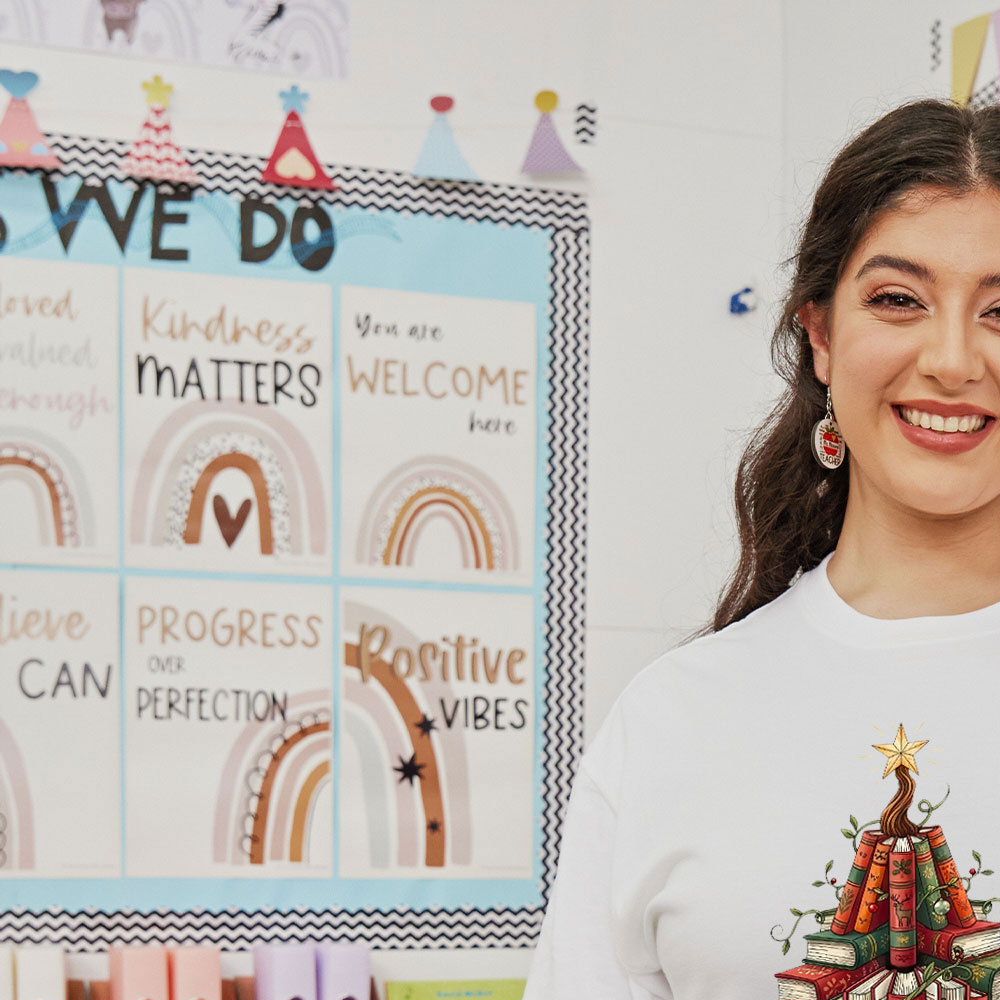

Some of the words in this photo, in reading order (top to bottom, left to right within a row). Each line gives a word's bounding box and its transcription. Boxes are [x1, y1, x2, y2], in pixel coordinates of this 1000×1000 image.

[41, 176, 192, 262] WE
[239, 200, 336, 272] DO
[141, 294, 317, 354] Kindness
[355, 312, 399, 339] You
[408, 323, 446, 343] are
[347, 353, 530, 406] WELCOME
[468, 410, 518, 435] here
[138, 605, 323, 648] PROGRESS
[149, 655, 186, 675] OVER
[359, 622, 528, 685] Positive
[18, 658, 112, 700] CAN
[136, 687, 288, 722] PERFECTION
[440, 695, 530, 731] VIBES
